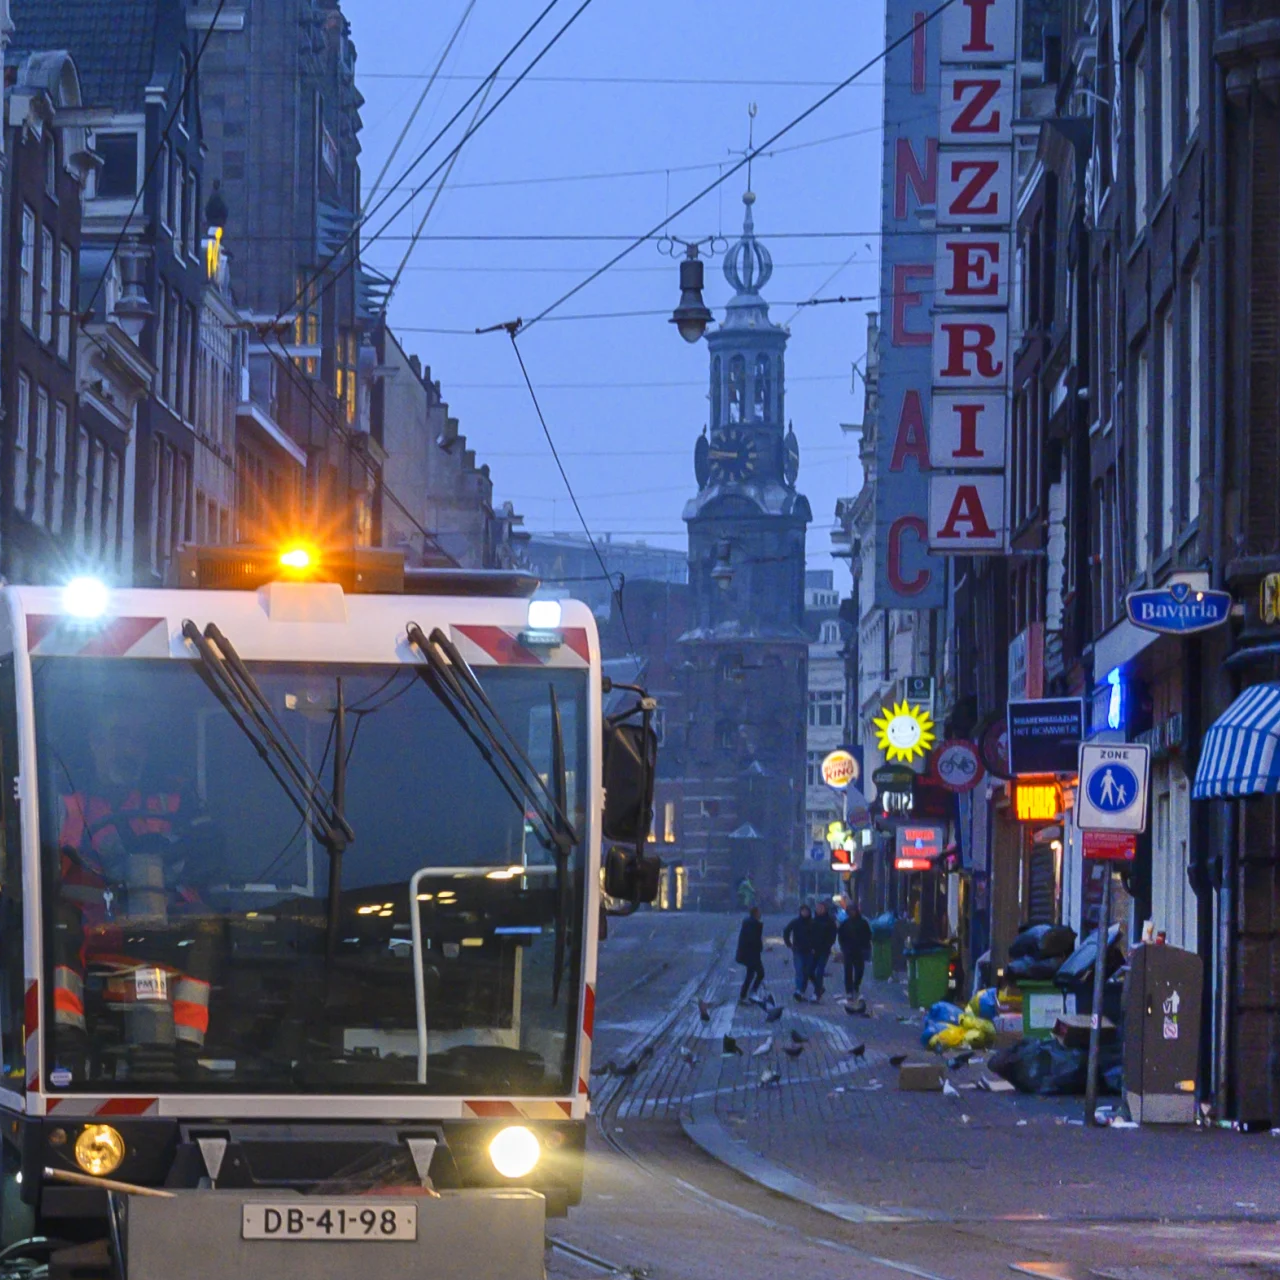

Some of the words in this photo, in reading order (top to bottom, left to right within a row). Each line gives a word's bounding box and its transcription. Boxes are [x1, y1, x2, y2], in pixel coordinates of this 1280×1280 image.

[1141, 601, 1218, 620] Bavaria
[1100, 750, 1129, 759] ZONE
[825, 766, 853, 783] KING
[264, 1208, 397, 1234] DB-41-98
